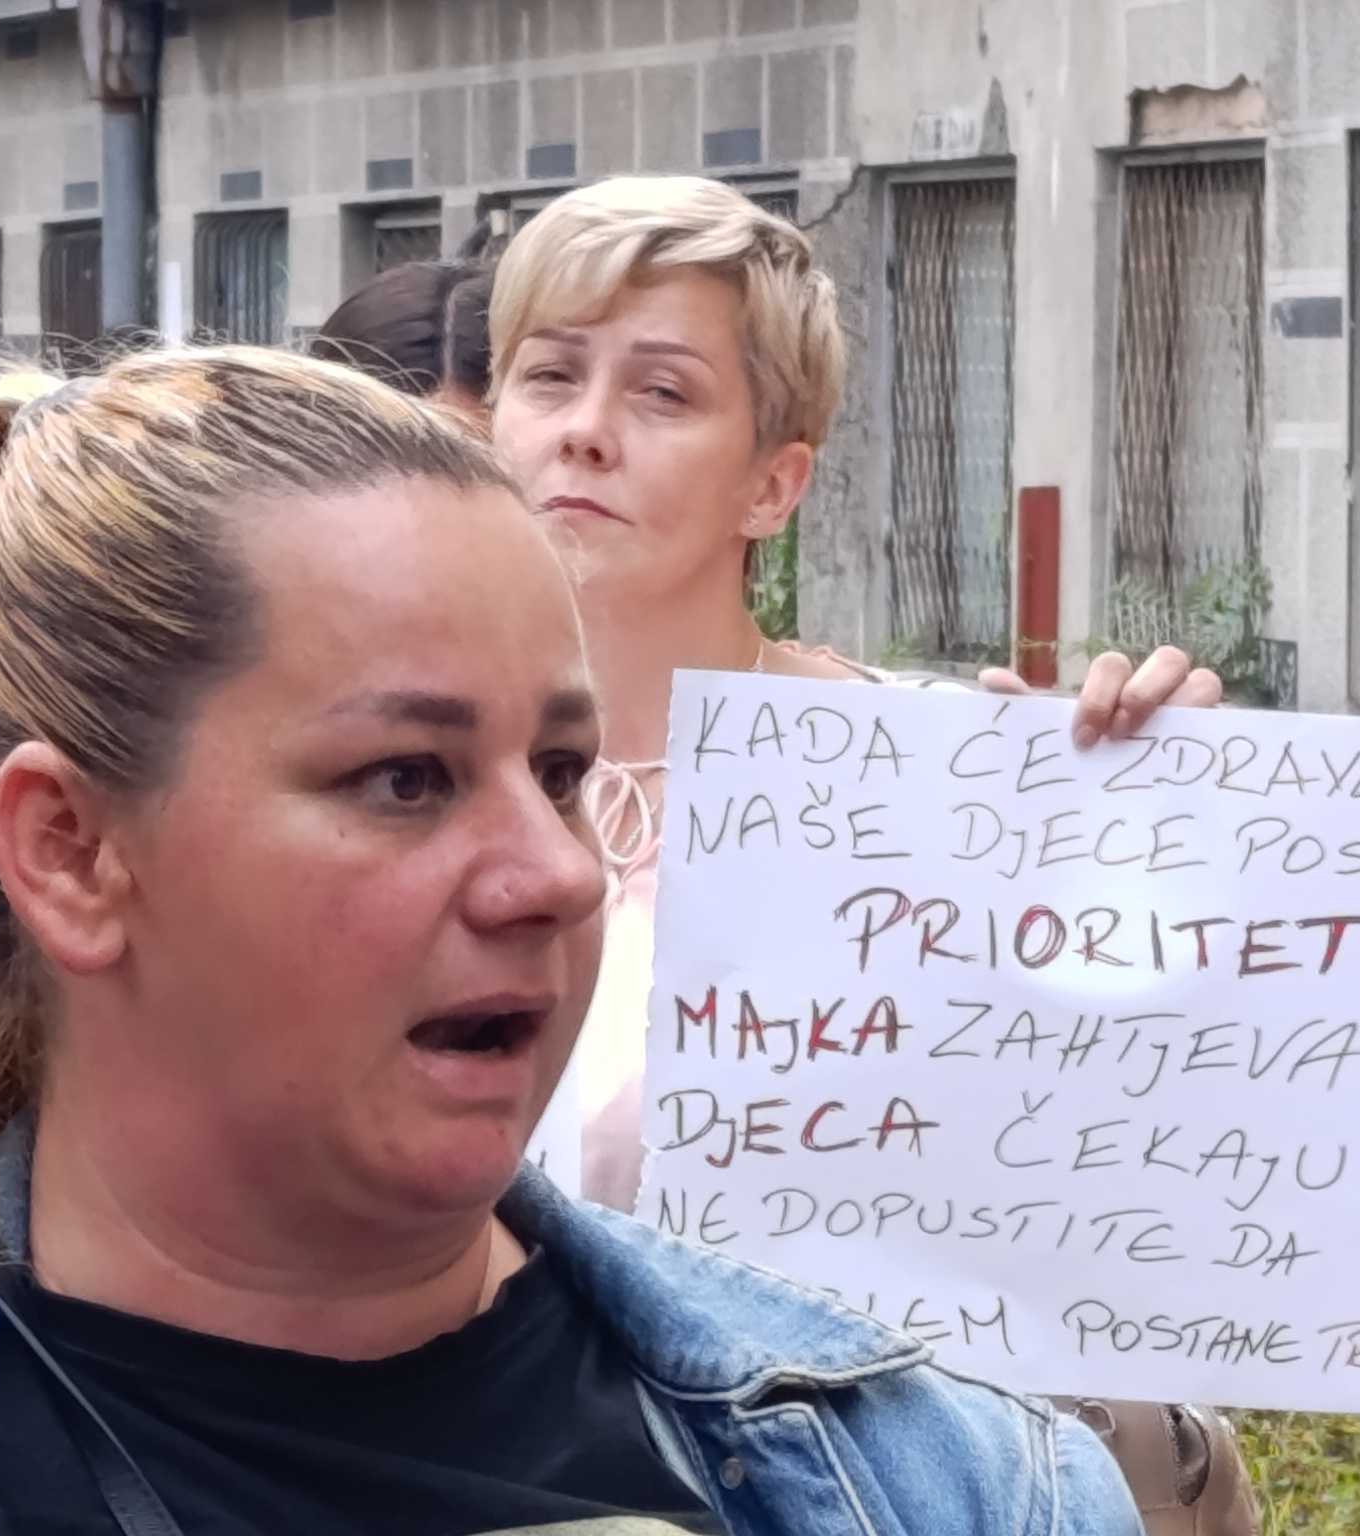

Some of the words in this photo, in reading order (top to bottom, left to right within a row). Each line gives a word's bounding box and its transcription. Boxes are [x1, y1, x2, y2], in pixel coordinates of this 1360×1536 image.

[692, 700, 914, 776] KADA
[947, 706, 1077, 796] ĆE
[684, 780, 912, 864] NAŠE
[951, 802, 1206, 880] DJECE
[672, 986, 912, 1074] MAJKA
[658, 1090, 938, 1168] DJECA
[994, 1092, 1350, 1212] ČEKAJU
[658, 1186, 740, 1245] NE
[762, 1186, 1188, 1266] DOPUSTITE
[1212, 1222, 1320, 1276] DA
[1062, 1300, 1304, 1366] POSTANE
